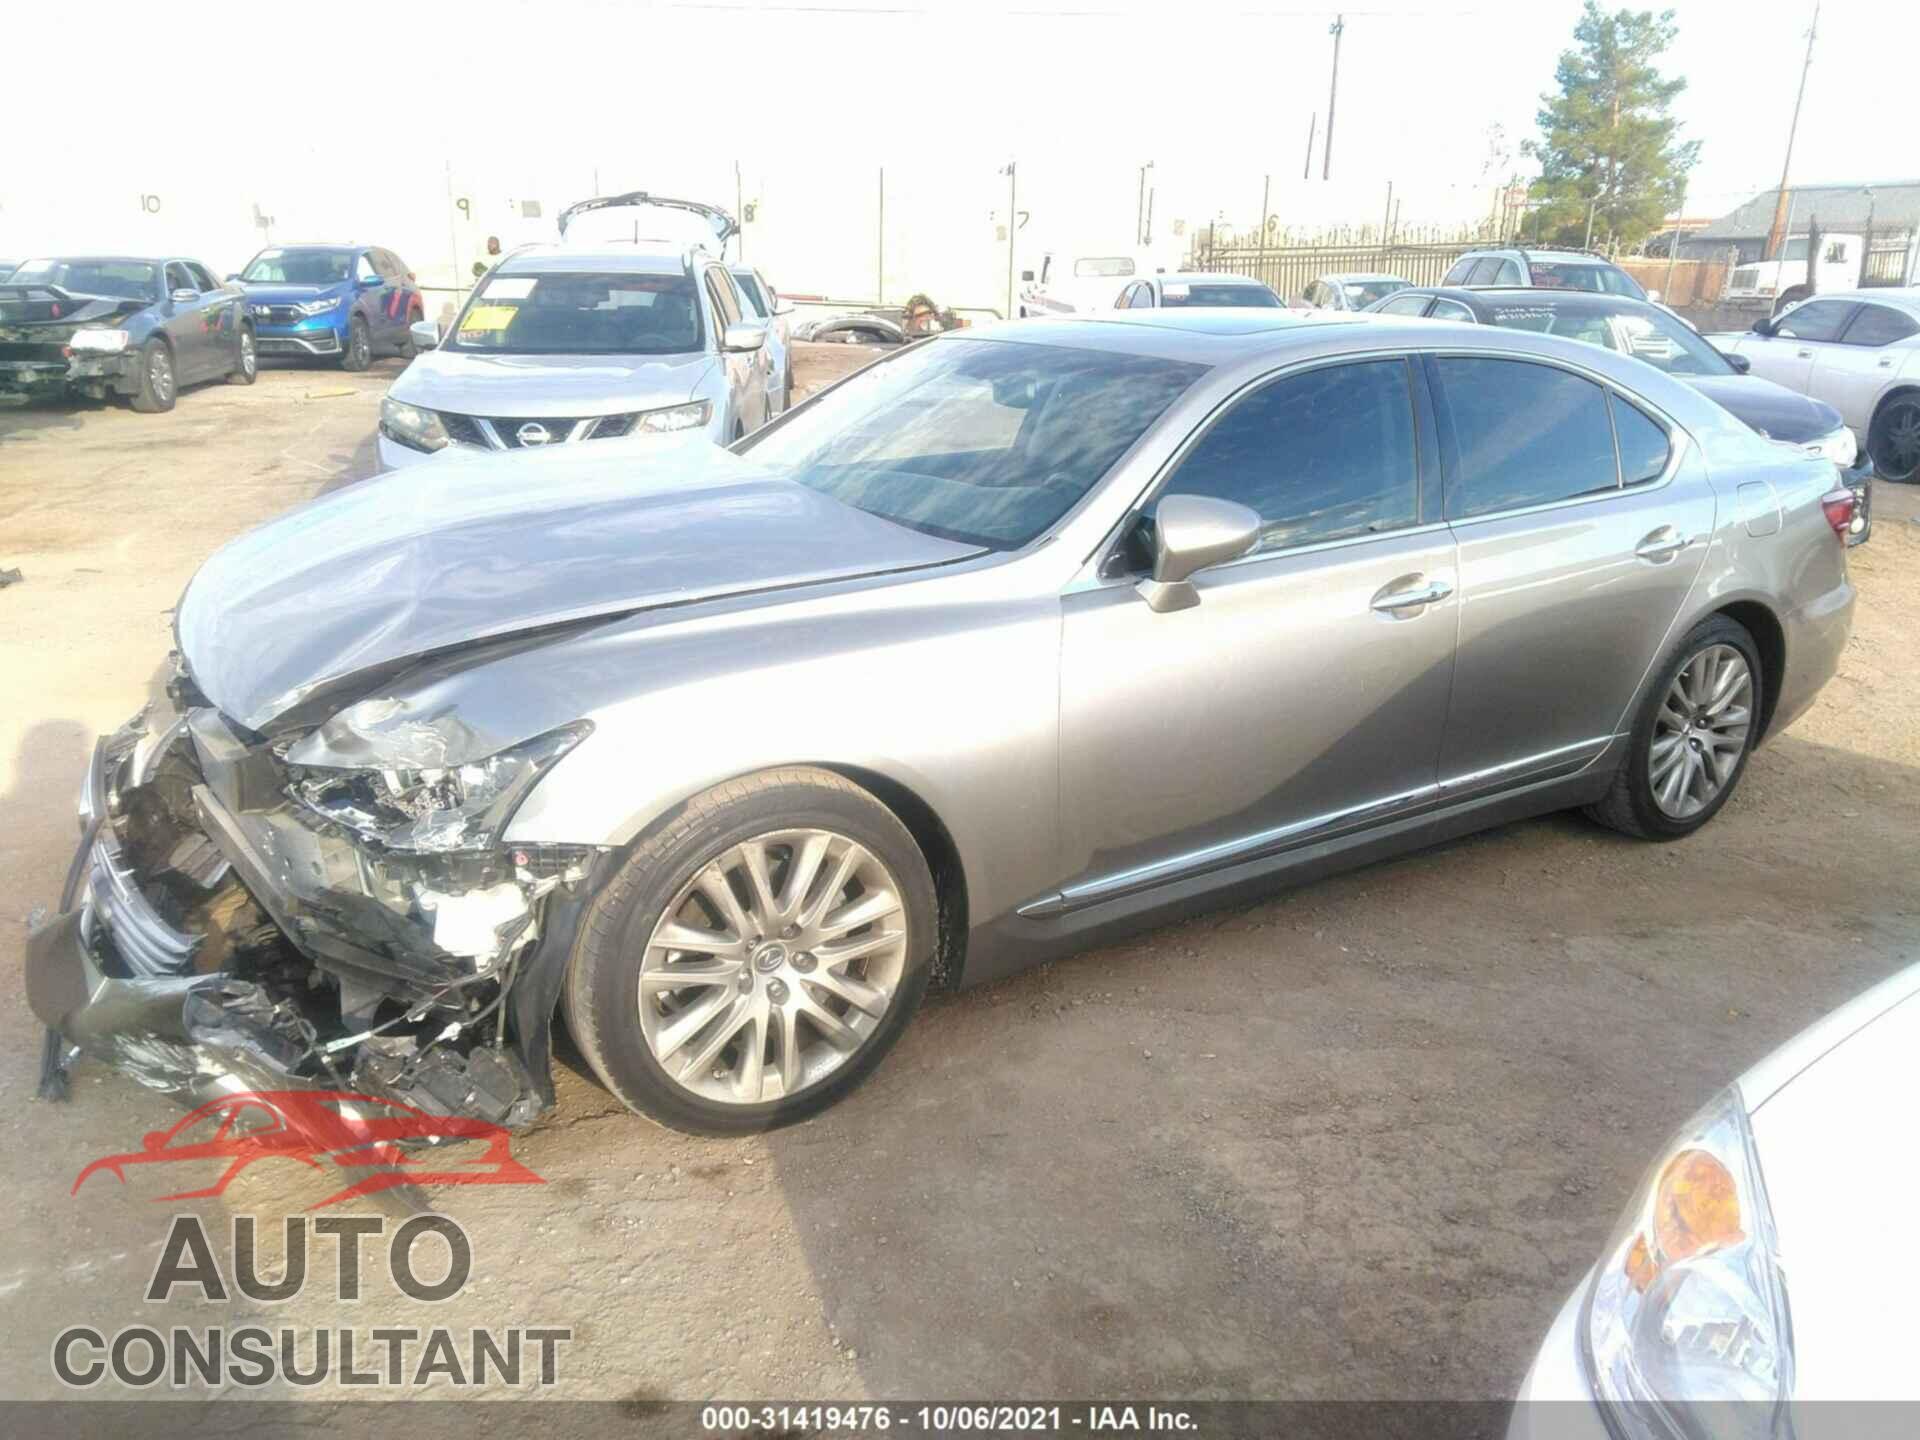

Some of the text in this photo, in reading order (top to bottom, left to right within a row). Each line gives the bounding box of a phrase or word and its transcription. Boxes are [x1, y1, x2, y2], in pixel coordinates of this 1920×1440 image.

[140, 194, 161, 213] 10
[456, 198, 470, 220] 9
[743, 203, 755, 222] 8
[1016, 210, 1029, 229] 7
[1267, 214, 1279, 232] 6
